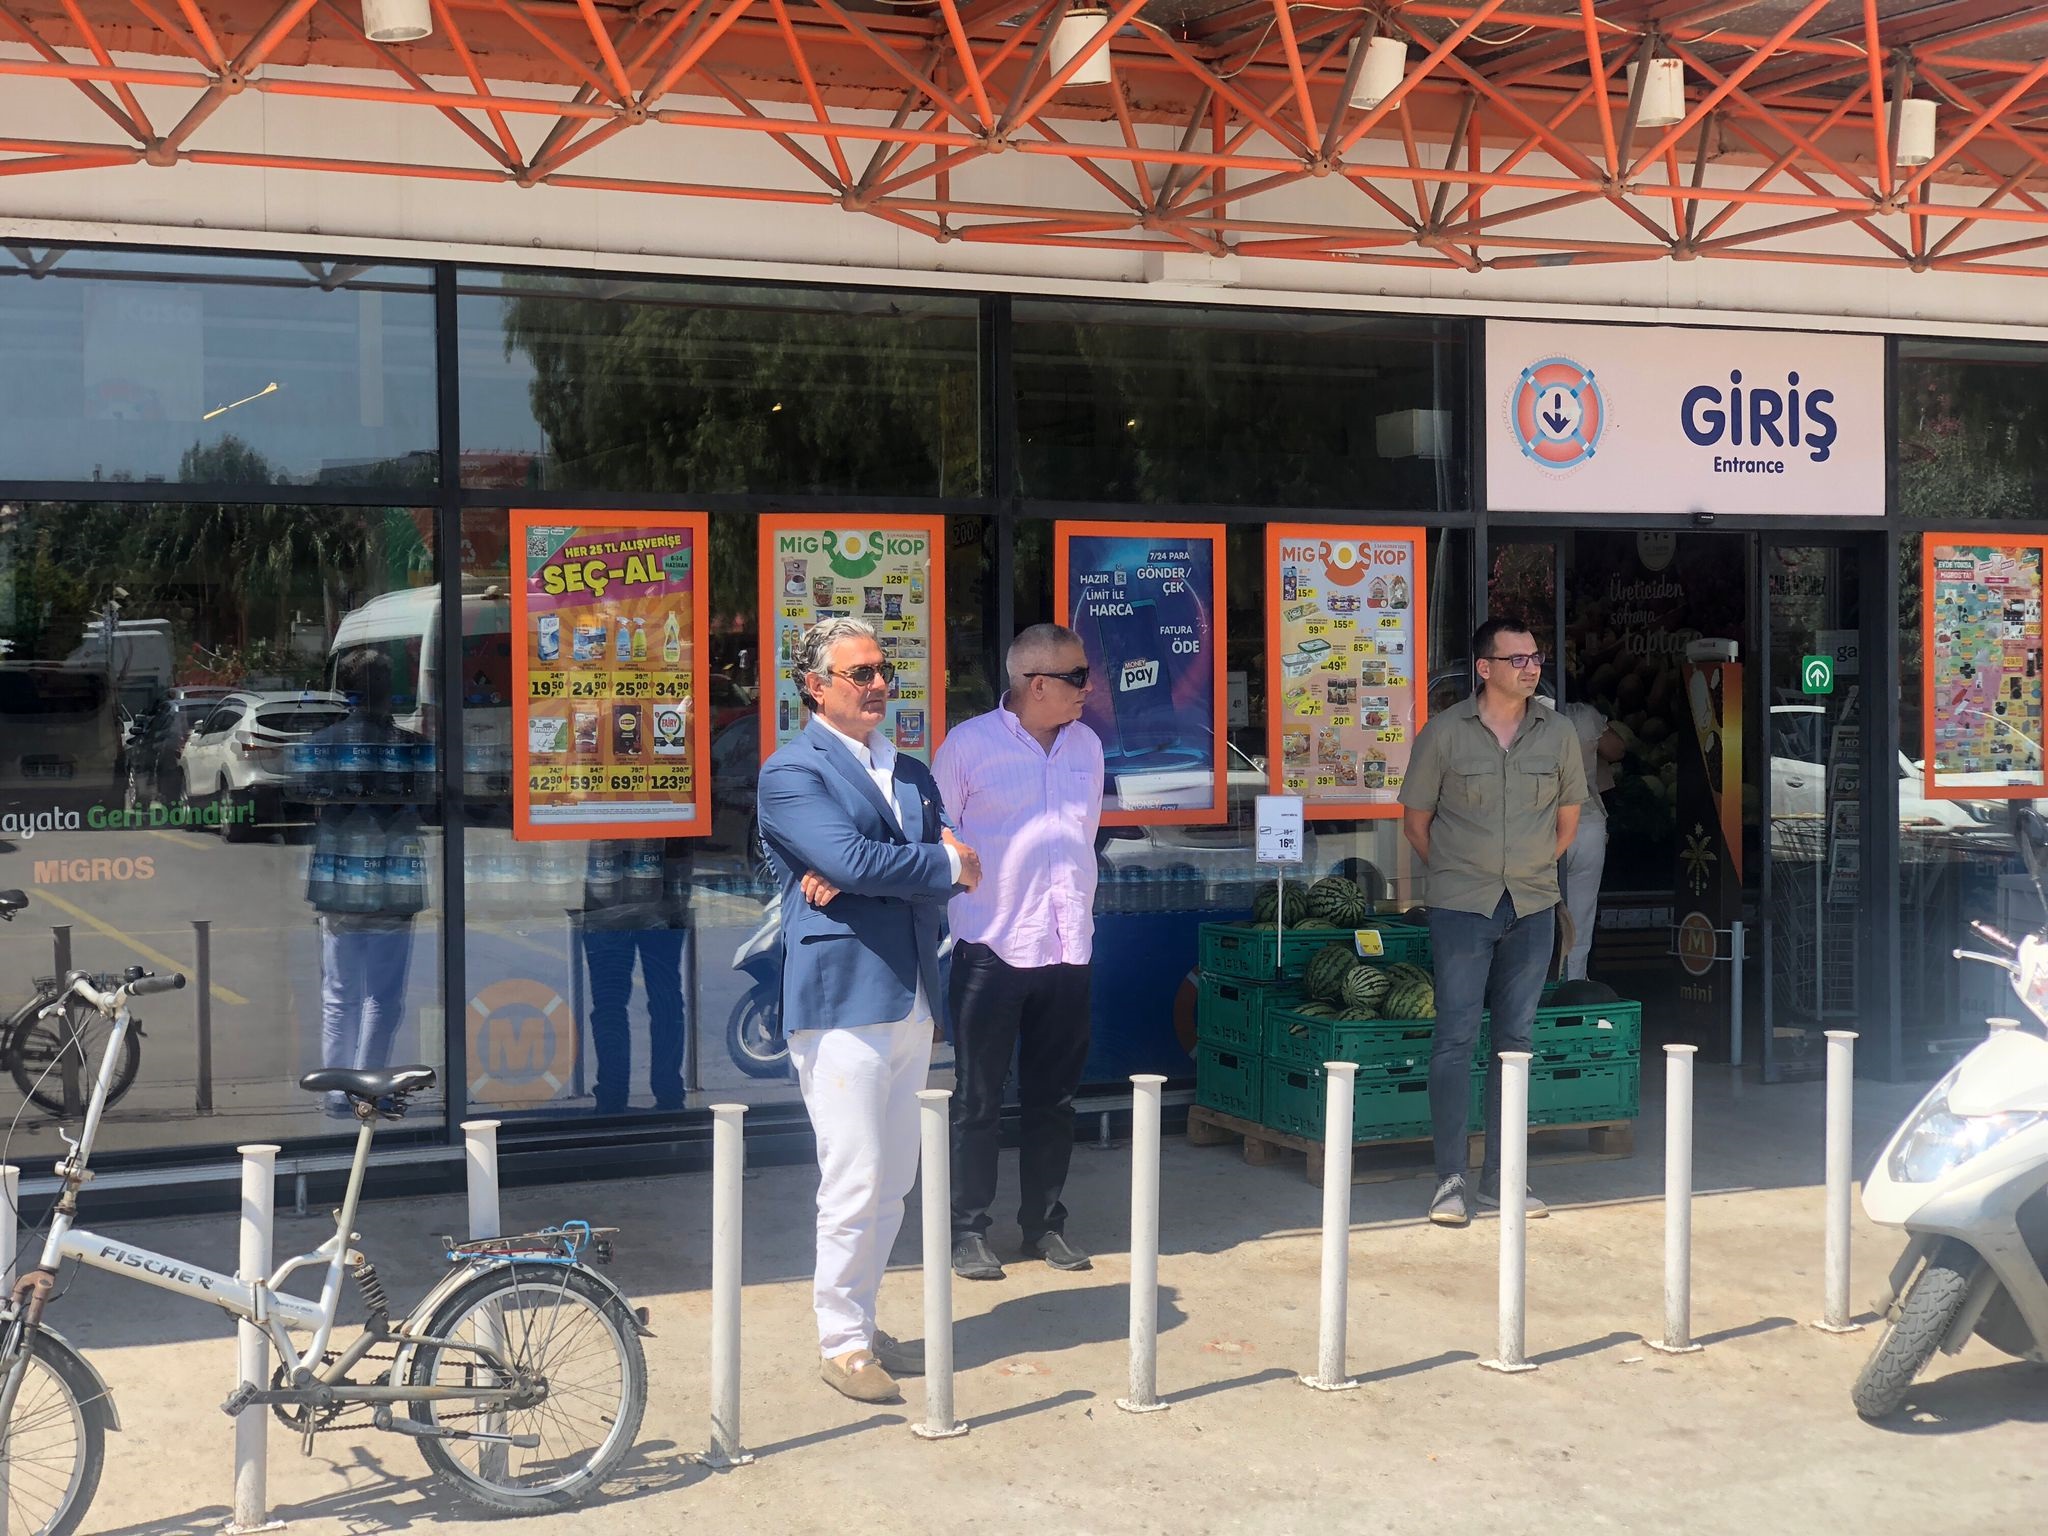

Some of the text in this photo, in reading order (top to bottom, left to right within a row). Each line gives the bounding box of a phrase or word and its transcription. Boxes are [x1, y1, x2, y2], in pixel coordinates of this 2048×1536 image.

[1681, 369, 1838, 462] GİRİŞ
[1713, 456, 1785, 474] Entrance
[565, 534, 682, 558] HER 25 TL ALIŞVERİŞE
[1149, 552, 1190, 561] 7/24 PARA
[543, 554, 666, 597] SEÇ-AL
[1080, 574, 1110, 584] HAZIR
[1086, 588, 1125, 601] LİMİT İLE
[1162, 582, 1185, 596] ÇEK
[1090, 603, 1134, 617] HARCA
[1160, 625, 1193, 635] FATURA
[1171, 638, 1200, 653] ÖDE
[1124, 658, 1147, 670] MONEY
[1125, 666, 1154, 688] pay
[1, 799, 256, 840] ayata Geri Döndür!
[1680, 983, 1712, 1003] mini
[489, 1017, 546, 1073] M
[99, 1245, 215, 1290] FISCHER
